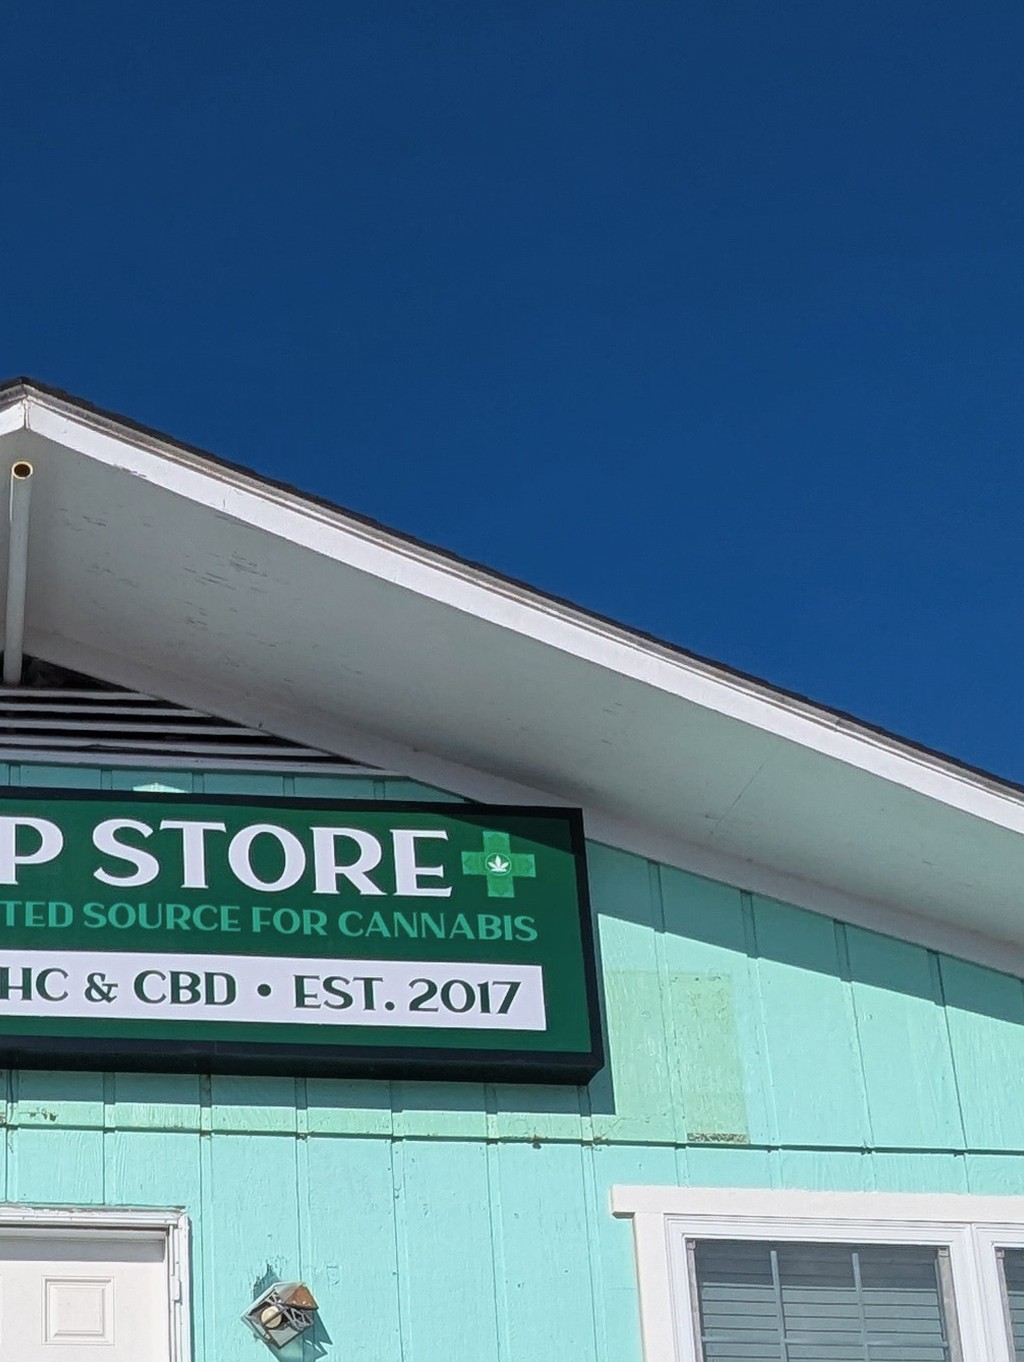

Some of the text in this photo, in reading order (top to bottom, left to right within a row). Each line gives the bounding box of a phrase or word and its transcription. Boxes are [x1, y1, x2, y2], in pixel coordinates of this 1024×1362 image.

[92, 818, 453, 898] STORE
[82, 902, 241, 933] SOURCE
[252, 907, 328, 937] FOR
[338, 910, 538, 942] CANNABIS
[84, 972, 119, 1004] &
[133, 970, 238, 1007] CBD
[293, 974, 396, 1012] EST.
[409, 978, 521, 1015] 2017
